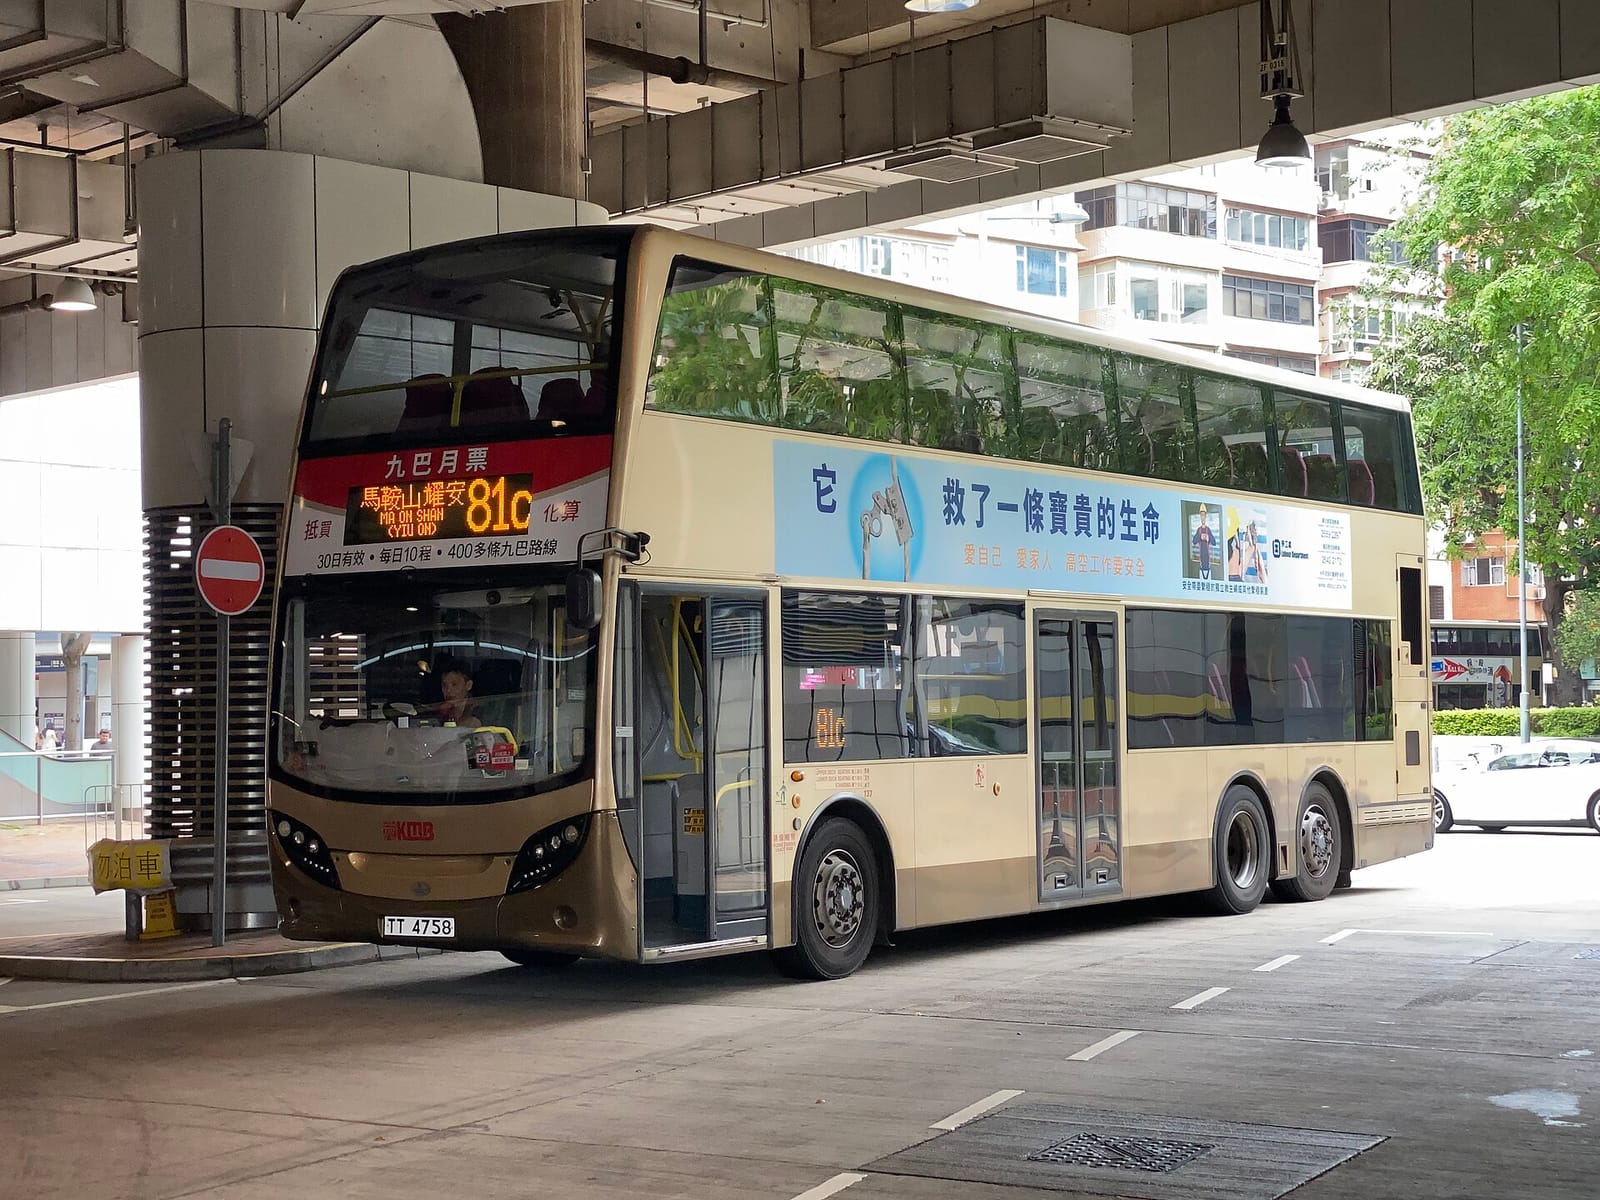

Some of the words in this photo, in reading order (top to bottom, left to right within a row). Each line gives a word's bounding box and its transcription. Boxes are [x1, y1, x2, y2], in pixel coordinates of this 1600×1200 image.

[385, 448, 489, 478] 九巴月票
[360, 481, 466, 512] 馬鞍山耀安
[543, 500, 581, 523] 化算
[812, 463, 837, 514] 它
[942, 477, 1160, 545] 救了一條寶貴的生命
[304, 519, 332, 541] 抵買
[380, 511, 395, 525] MA
[399, 509, 413, 523] ON
[416, 507, 444, 522] SHAN
[388, 523, 414, 538] (YIU
[417, 522, 437, 536] ON)
[317, 551, 365, 570] 30日有效
[379, 546, 432, 564] 每日10程
[448, 539, 558, 559] 400多條九巴路線
[964, 543, 1003, 568] 愛自己
[1016, 547, 1053, 571] 愛家人
[1066, 551, 1145, 578] 高空工作要安全
[97, 850, 162, 881] 勿泊車
[387, 918, 405, 934] TT
[412, 919, 451, 935] 4758
